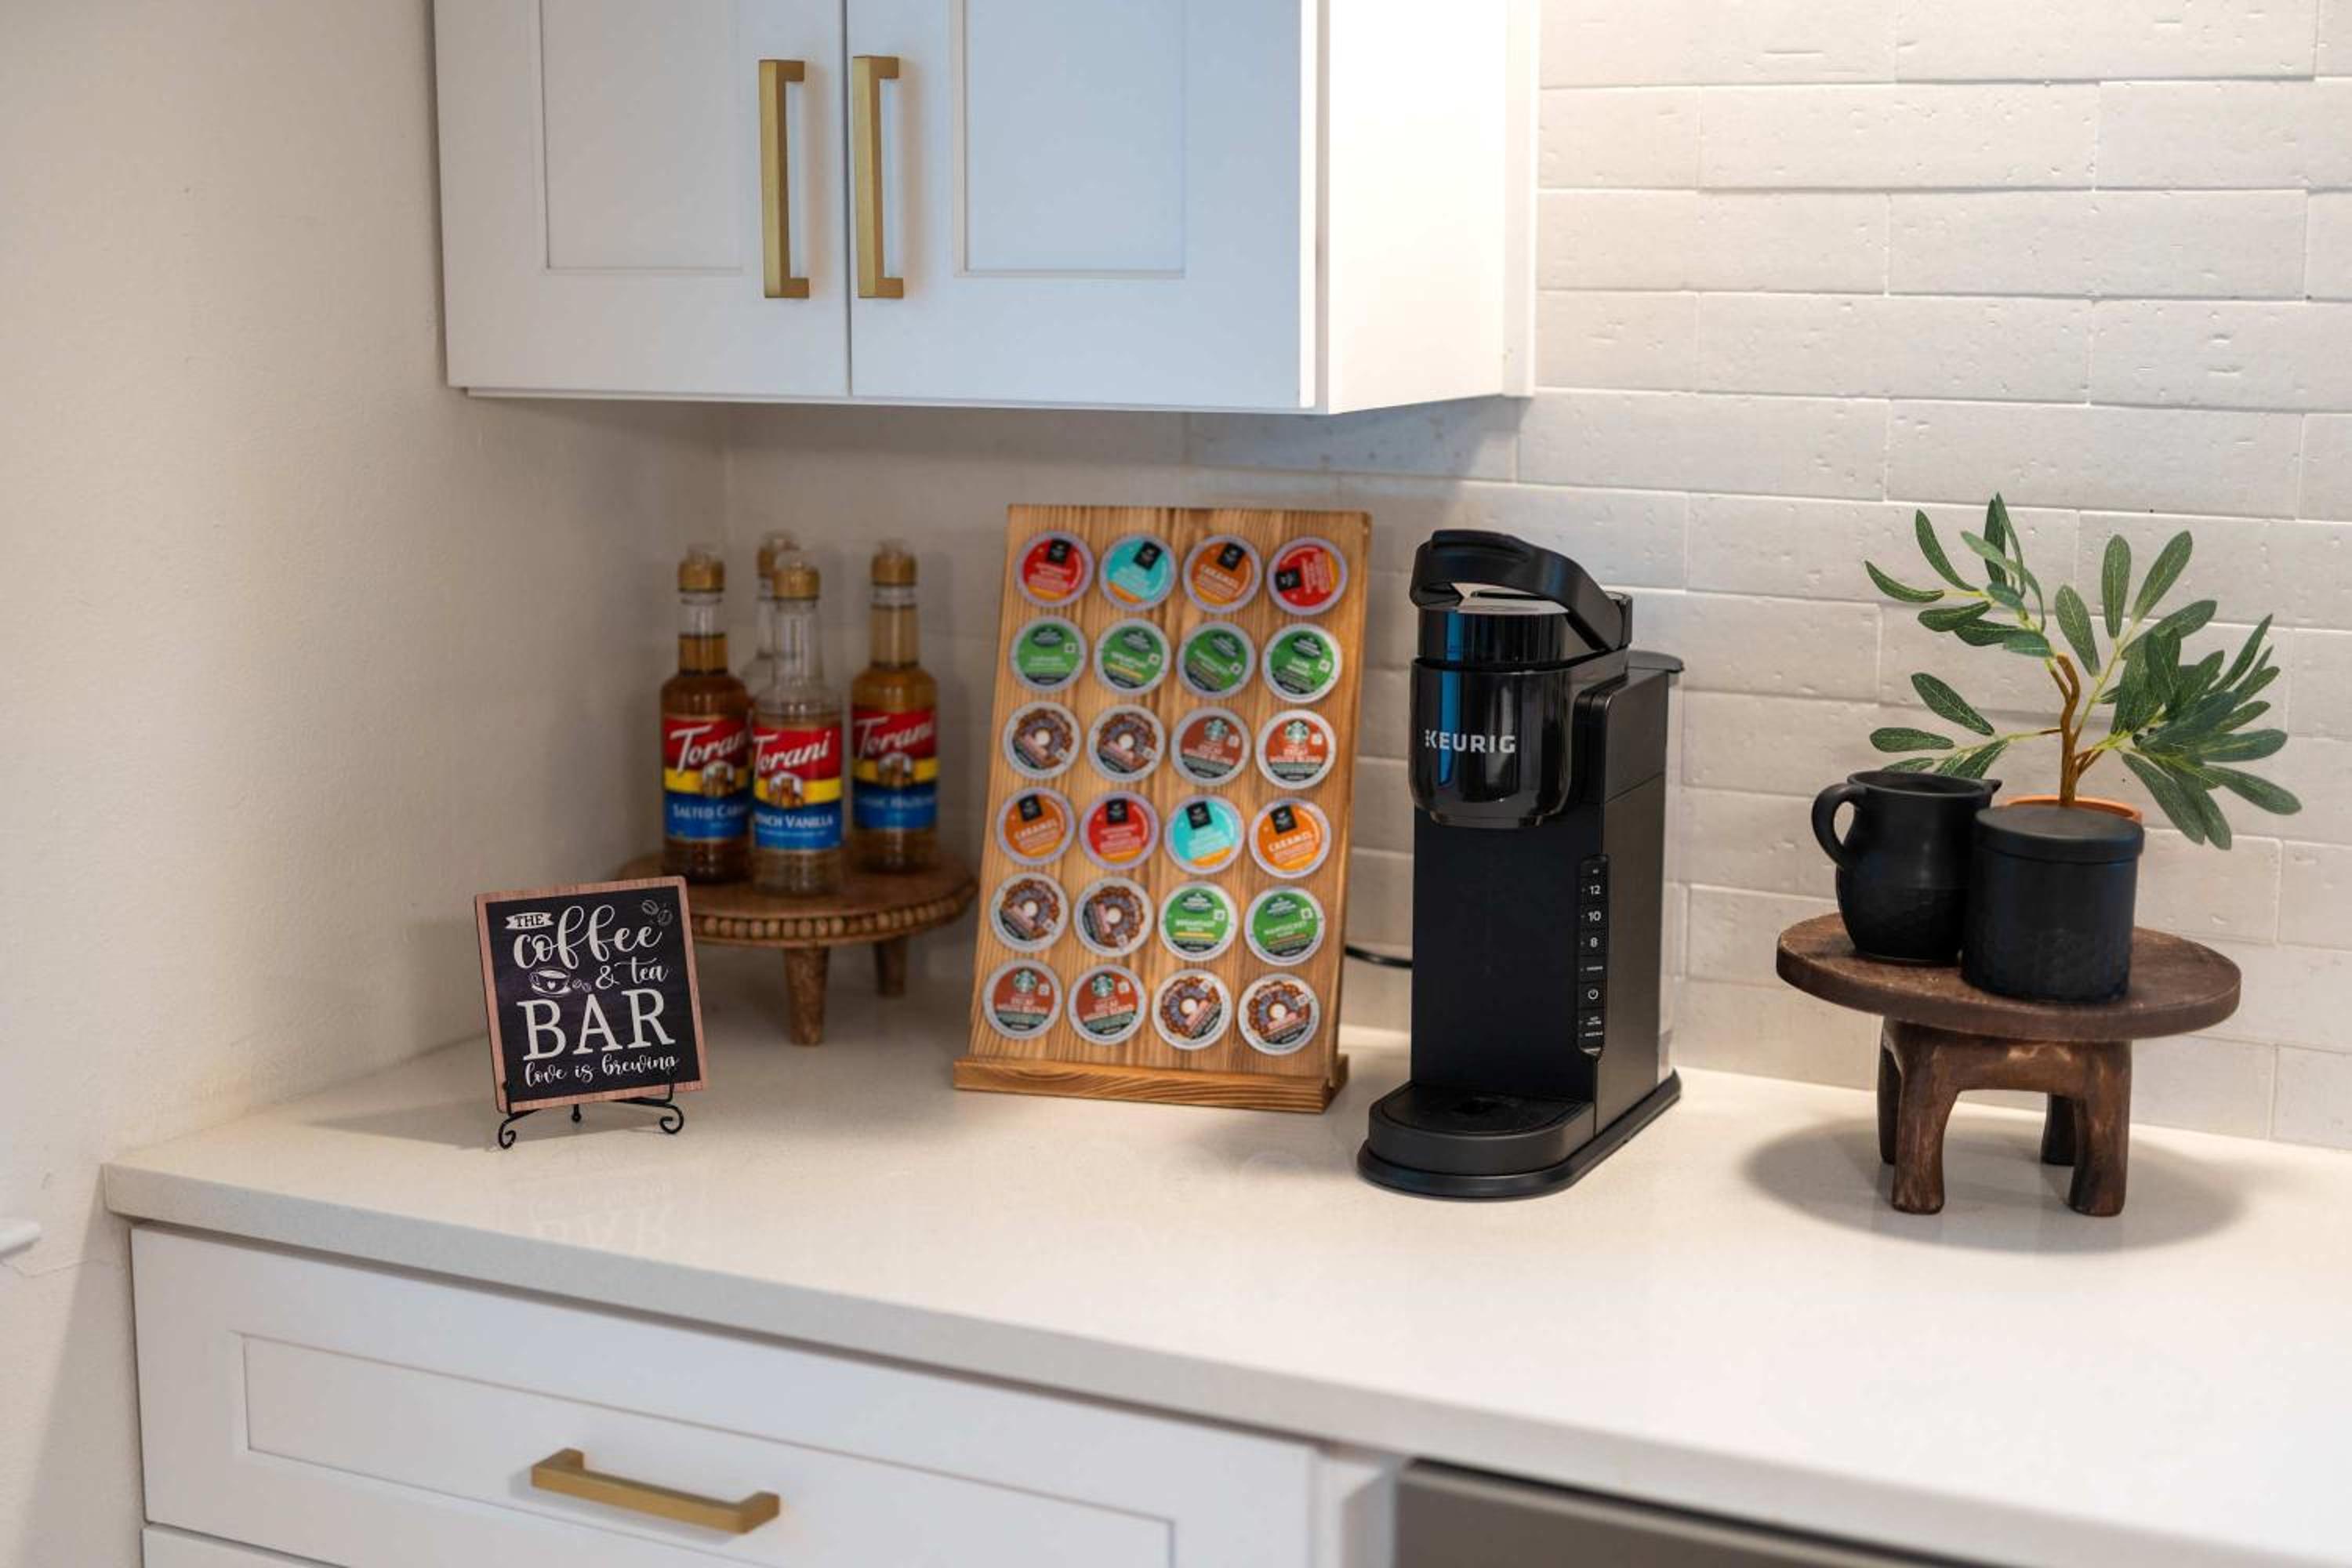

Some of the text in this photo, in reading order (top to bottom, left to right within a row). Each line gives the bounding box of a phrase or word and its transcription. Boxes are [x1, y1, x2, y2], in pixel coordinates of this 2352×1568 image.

[1425, 729, 1516, 753] KEURIG
[753, 730, 832, 782] Torani
[785, 813, 833, 829] VANILLA
[1589, 884, 1600, 895] 12
[515, 913, 544, 928] THE
[1588, 910, 1602, 922] 10
[1590, 937, 1598, 948] 8
[596, 956, 670, 990] & tea
[516, 988, 677, 1062] BAR
[525, 1054, 679, 1087] love is brewing
